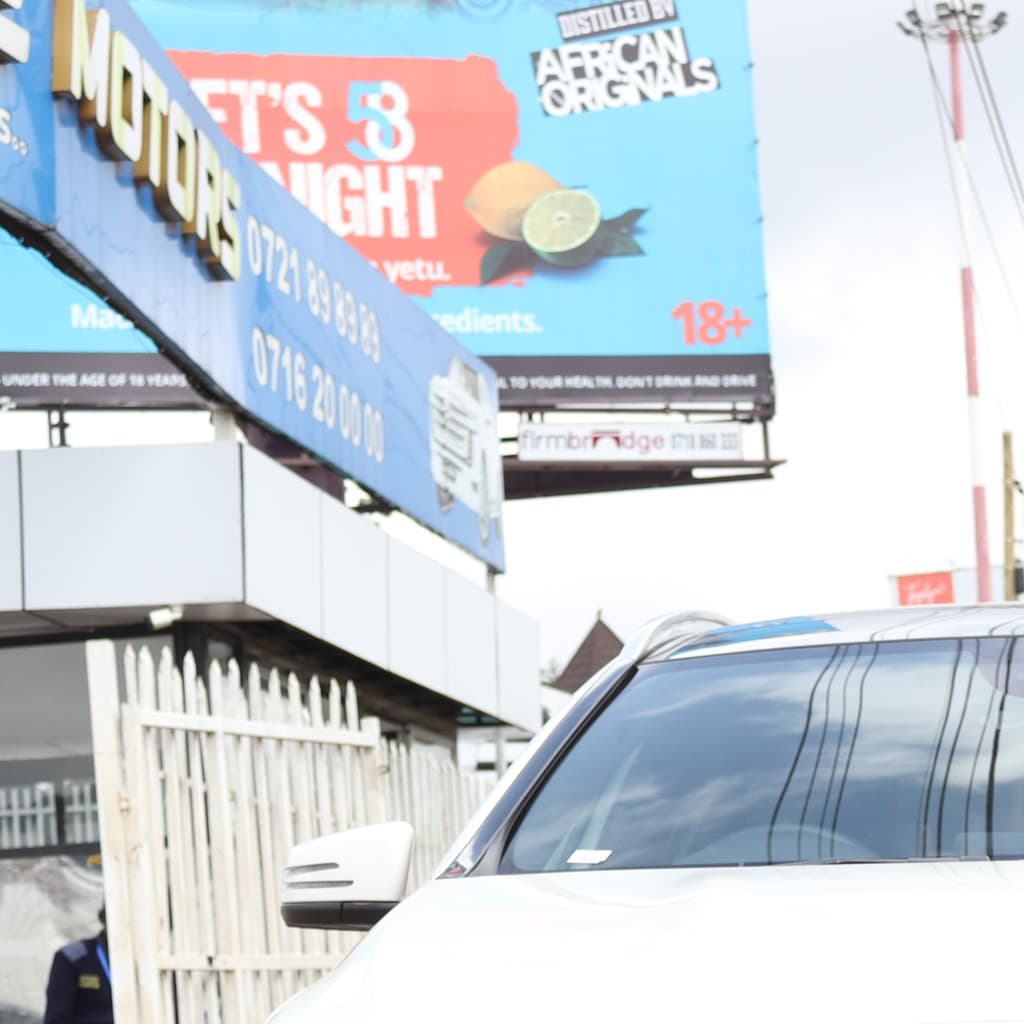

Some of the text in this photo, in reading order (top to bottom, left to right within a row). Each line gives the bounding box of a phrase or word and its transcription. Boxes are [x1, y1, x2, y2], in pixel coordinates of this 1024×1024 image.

[559, 0, 675, 38] DISTILLED BY
[536, 27, 688, 85] AFRICAN
[540, 57, 718, 117] ORIGINALS
[70, 0, 241, 281] MOTORS
[248, 216, 301, 301] 0721
[306, 259, 332, 325] 89
[333, 280, 359, 345] 89
[383, 259, 451, 283] yetu.
[671, 300, 752, 345] 18+
[2, 372, 50, 387] UNDER
[52, 372, 78, 387] THE
[79, 372, 107, 387] AGE
[108, 372, 127, 387] OF
[253, 326, 384, 463] 0716 20 00 00
[510, 375, 528, 389] TO
[529, 375, 562, 389] YOUR
[655, 374, 691, 388] DRINK
[694, 374, 719, 388] AND
[721, 373, 757, 388] DRIVE
